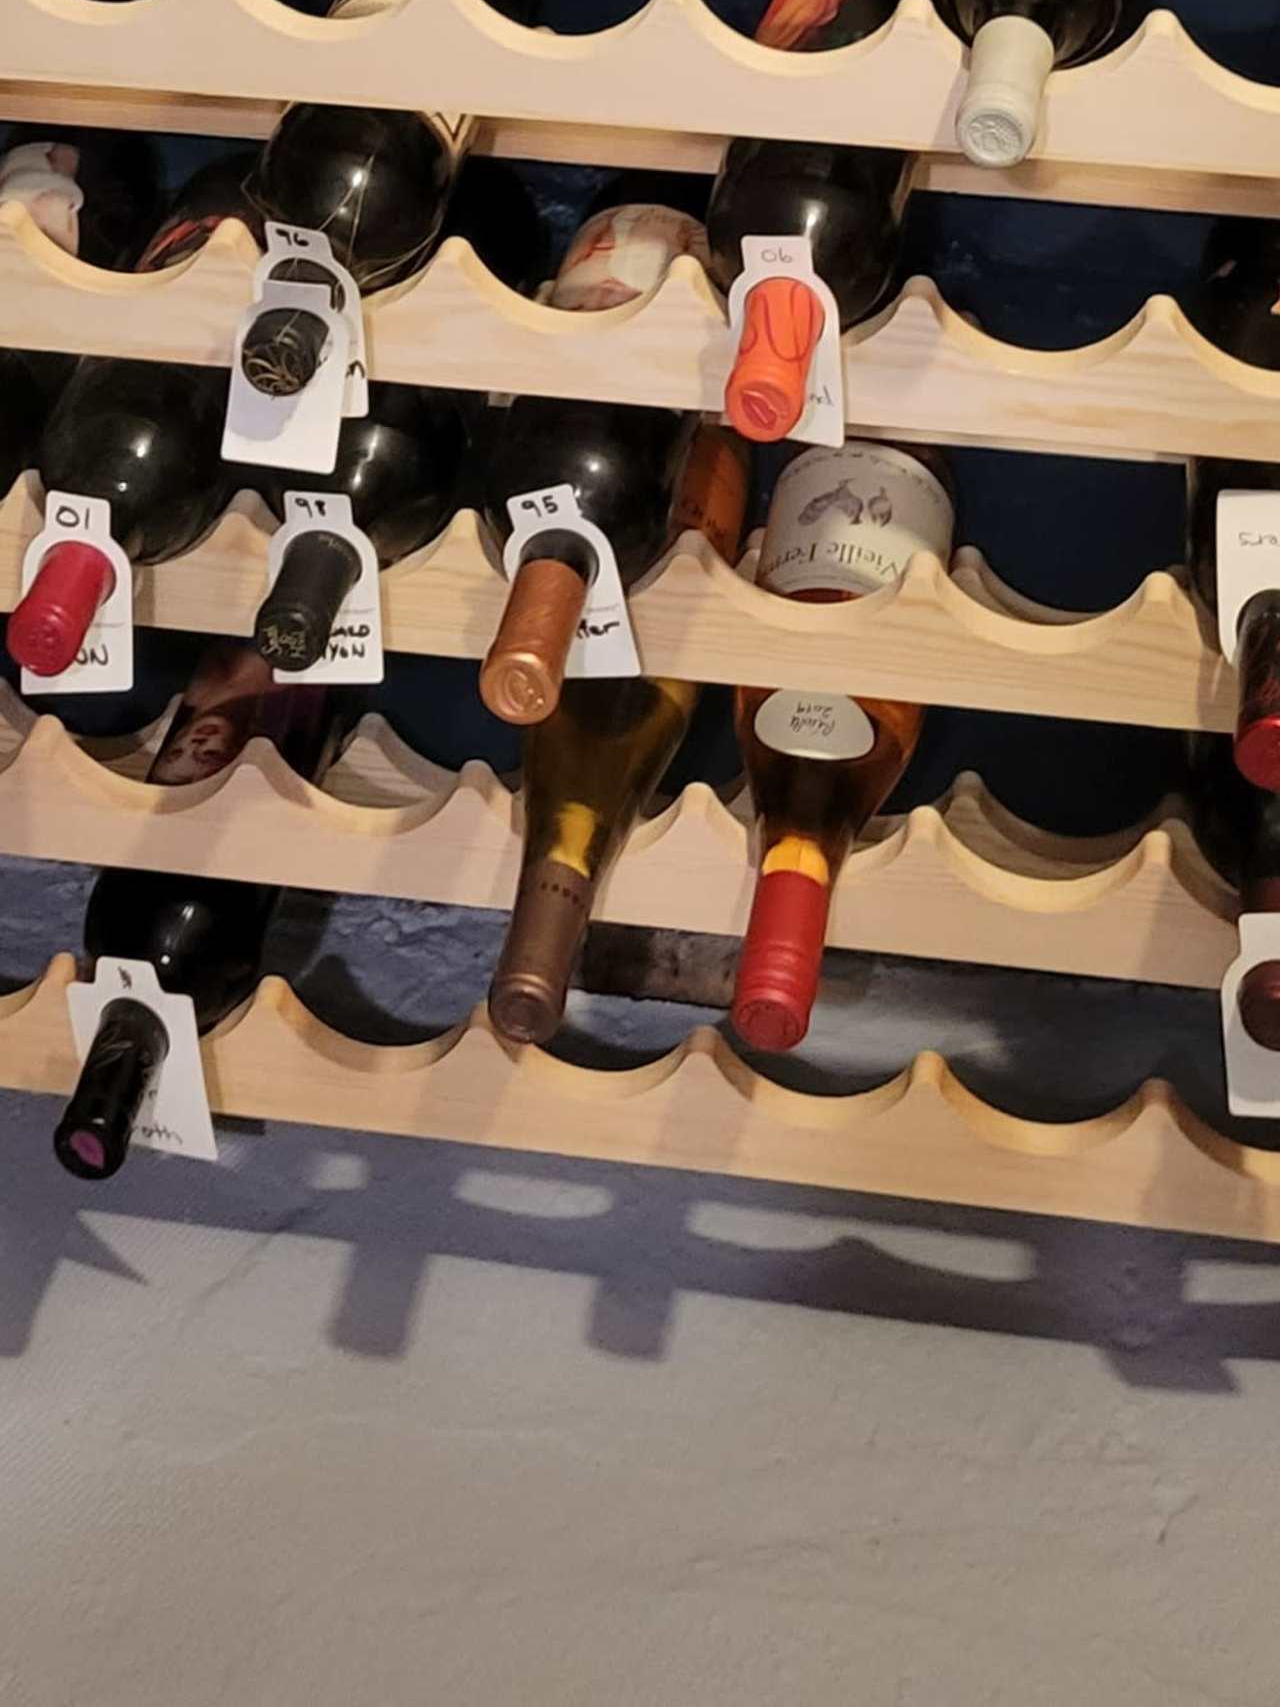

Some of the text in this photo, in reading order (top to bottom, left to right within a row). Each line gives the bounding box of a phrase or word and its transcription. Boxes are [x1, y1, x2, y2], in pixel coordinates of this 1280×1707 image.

[760, 247, 793, 264] 06
[294, 497, 327, 518] 98
[521, 494, 558, 518] 95
[826, 540, 899, 577] Vieille
